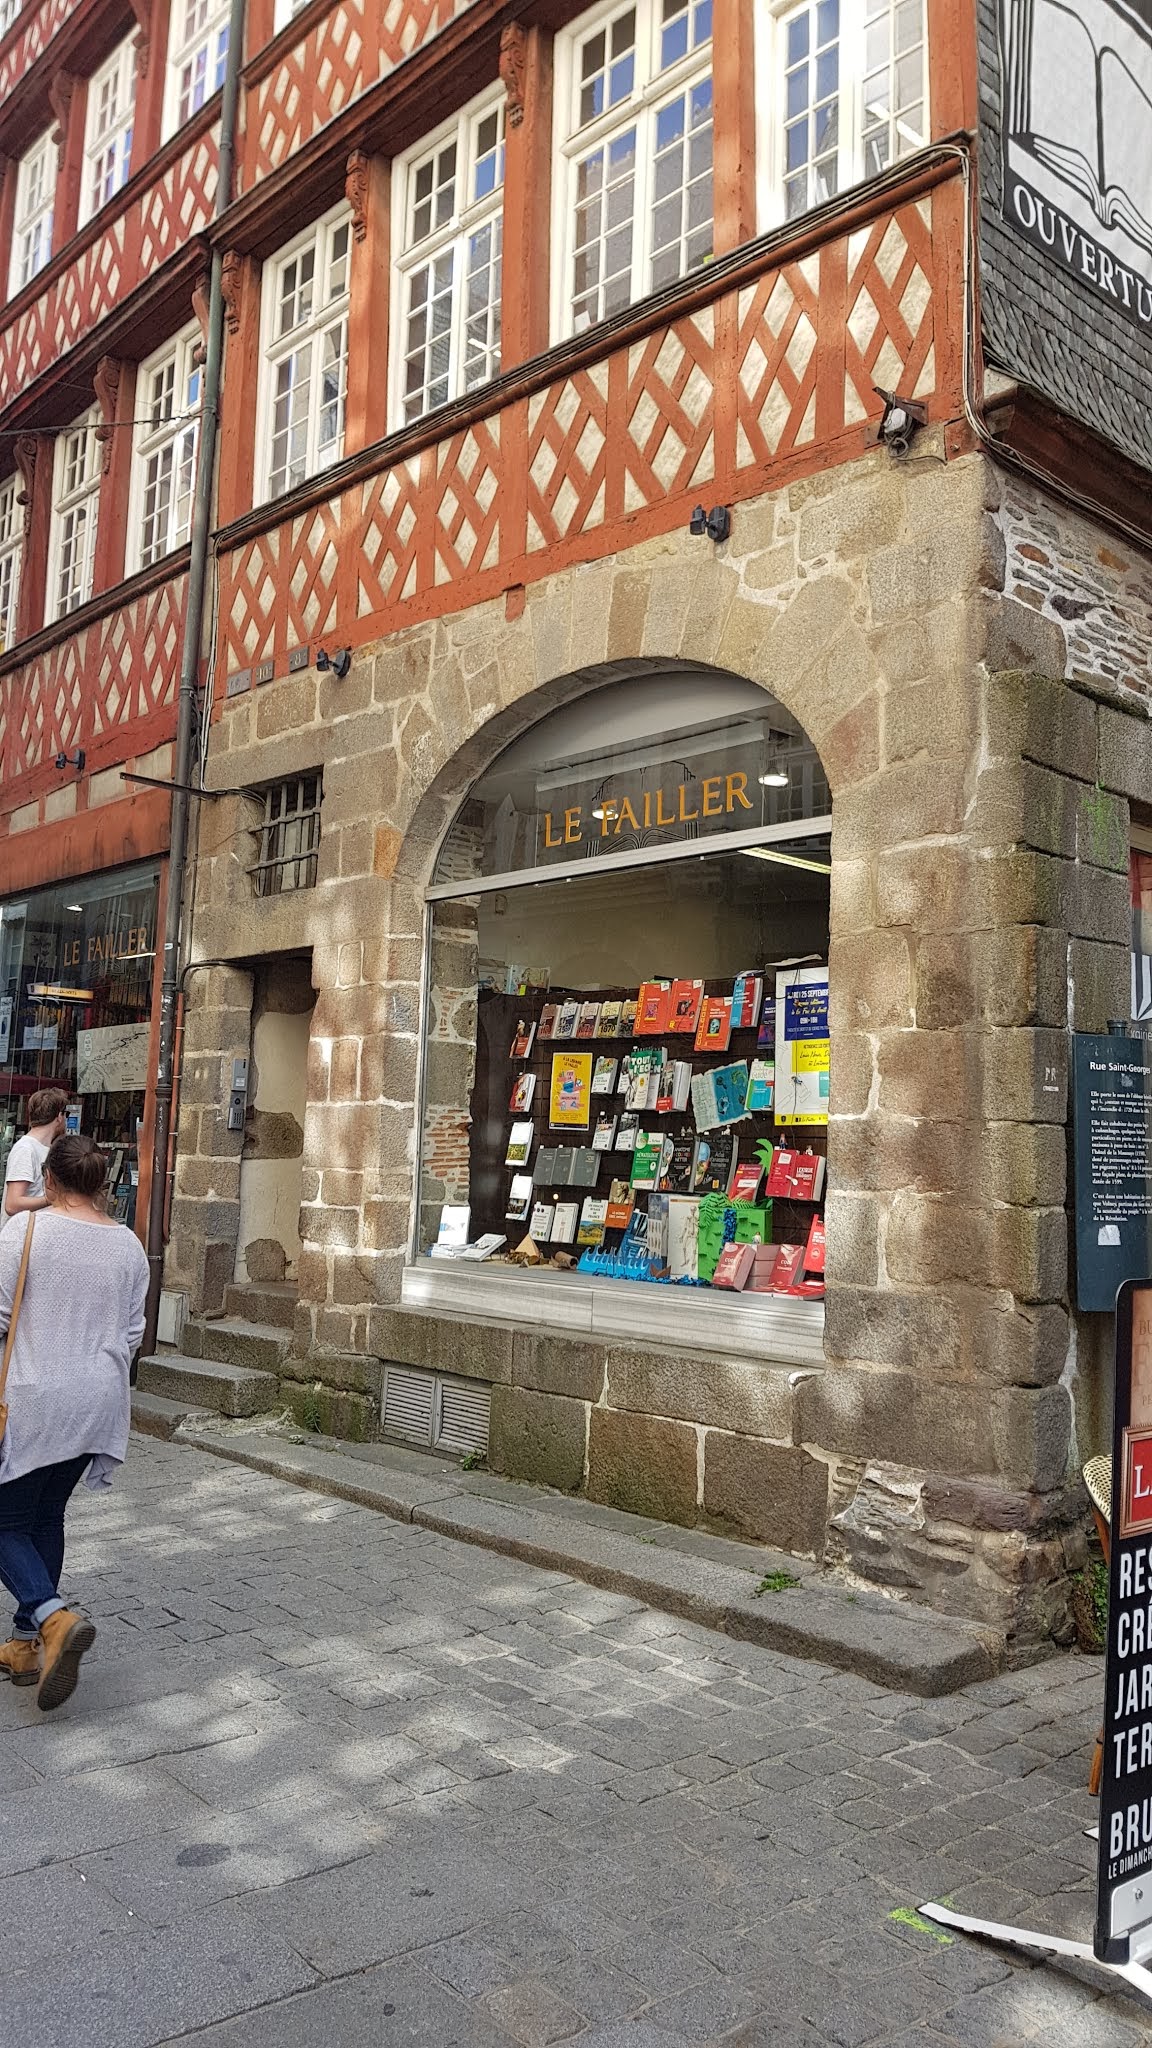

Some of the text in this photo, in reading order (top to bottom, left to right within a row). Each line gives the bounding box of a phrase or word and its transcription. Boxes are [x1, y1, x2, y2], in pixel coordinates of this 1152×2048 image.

[1013, 184, 1152, 322] OUVERTU
[544, 771, 754, 848] LE FAILLER
[63, 927, 148, 967] LE FAILLER
[1090, 1061, 1151, 1075] Rue Saint-Georges
[1133, 1464, 1152, 1499] L
[1114, 1663, 1152, 1720] JAR
[1113, 1722, 1152, 1779] TER
[1109, 1796, 1152, 1859] BRU
[1108, 1862, 1117, 1880] LE
